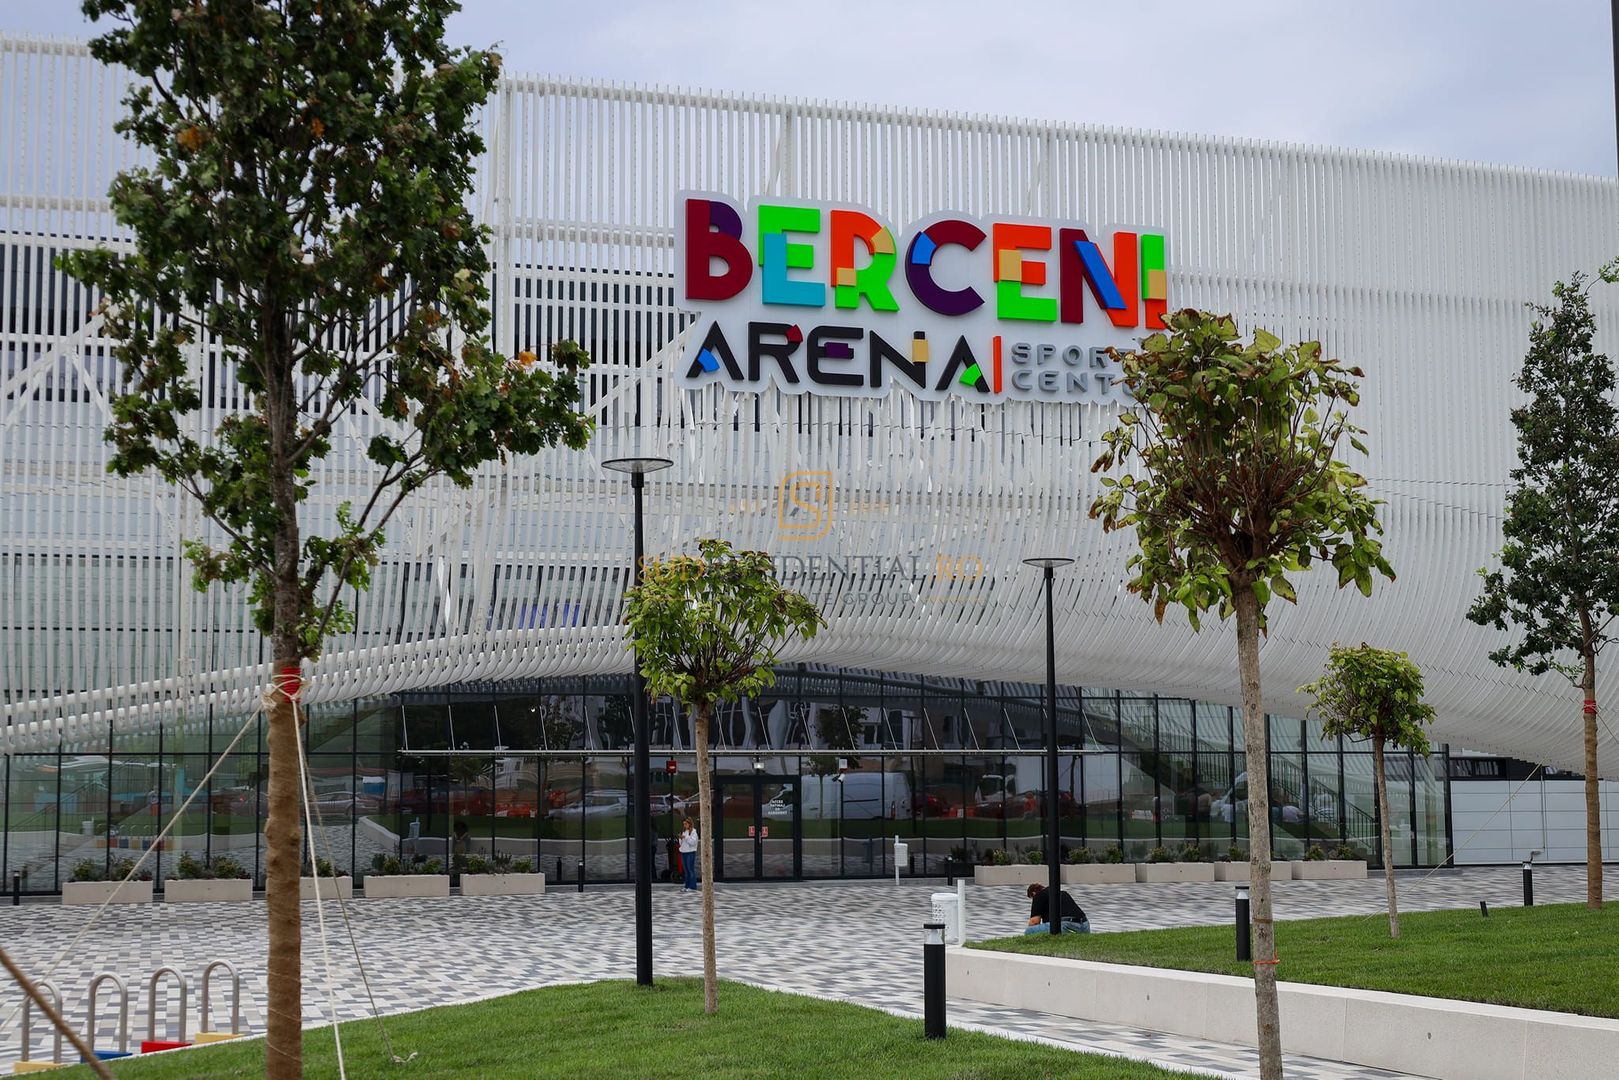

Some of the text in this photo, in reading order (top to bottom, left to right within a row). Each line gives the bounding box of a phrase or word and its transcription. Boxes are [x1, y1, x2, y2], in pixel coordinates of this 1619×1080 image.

[685, 198, 1168, 330] BERCENI
[686, 320, 990, 394] ARENA
[1011, 342, 1136, 369] SPOR
[1011, 369, 1136, 396] CENT
